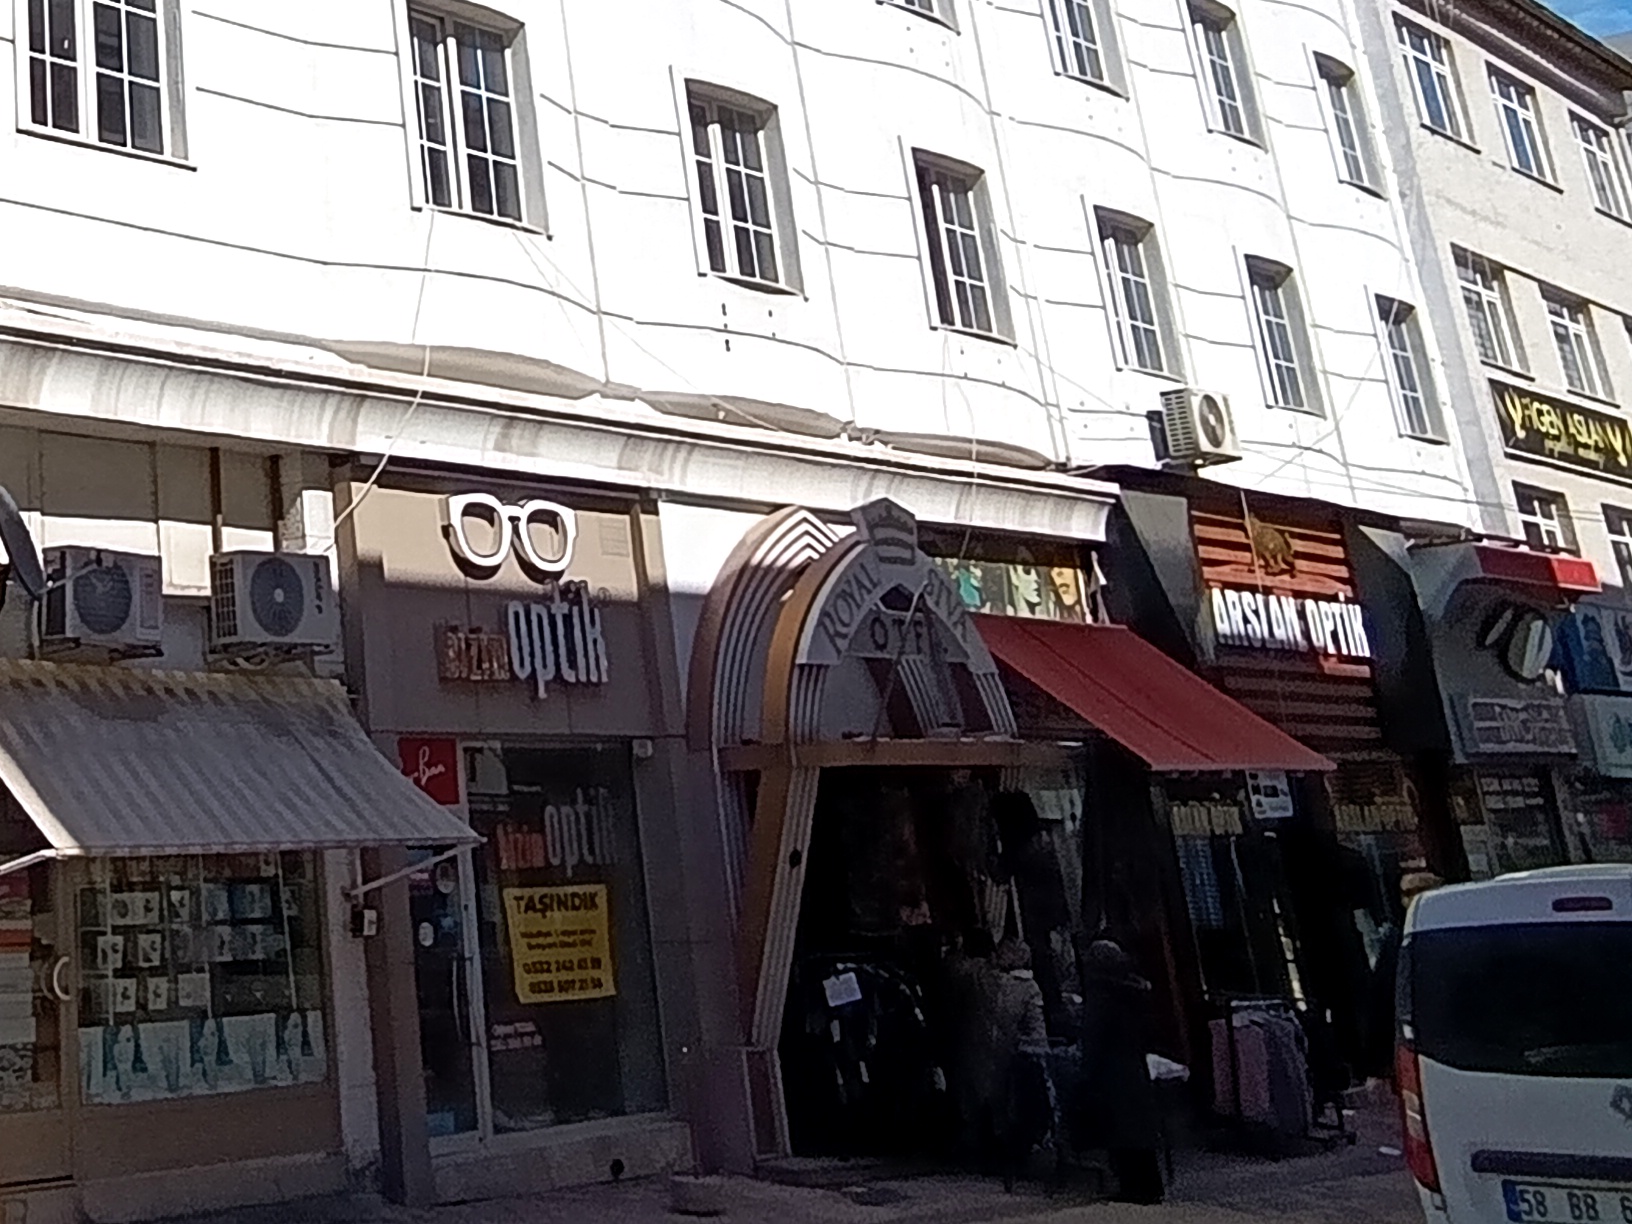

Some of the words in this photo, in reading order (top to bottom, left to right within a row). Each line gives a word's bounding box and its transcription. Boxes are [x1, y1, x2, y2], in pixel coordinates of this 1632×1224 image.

[507, 579, 609, 699] optik
[822, 562, 881, 657] ROYAL
[1212, 587, 1309, 652] ARSLAN
[1304, 591, 1371, 657] OPTİK
[513, 891, 599, 919] TAŞINDIK
[1518, 1188, 1548, 1219] 58
[1566, 1191, 1600, 1222] BB
